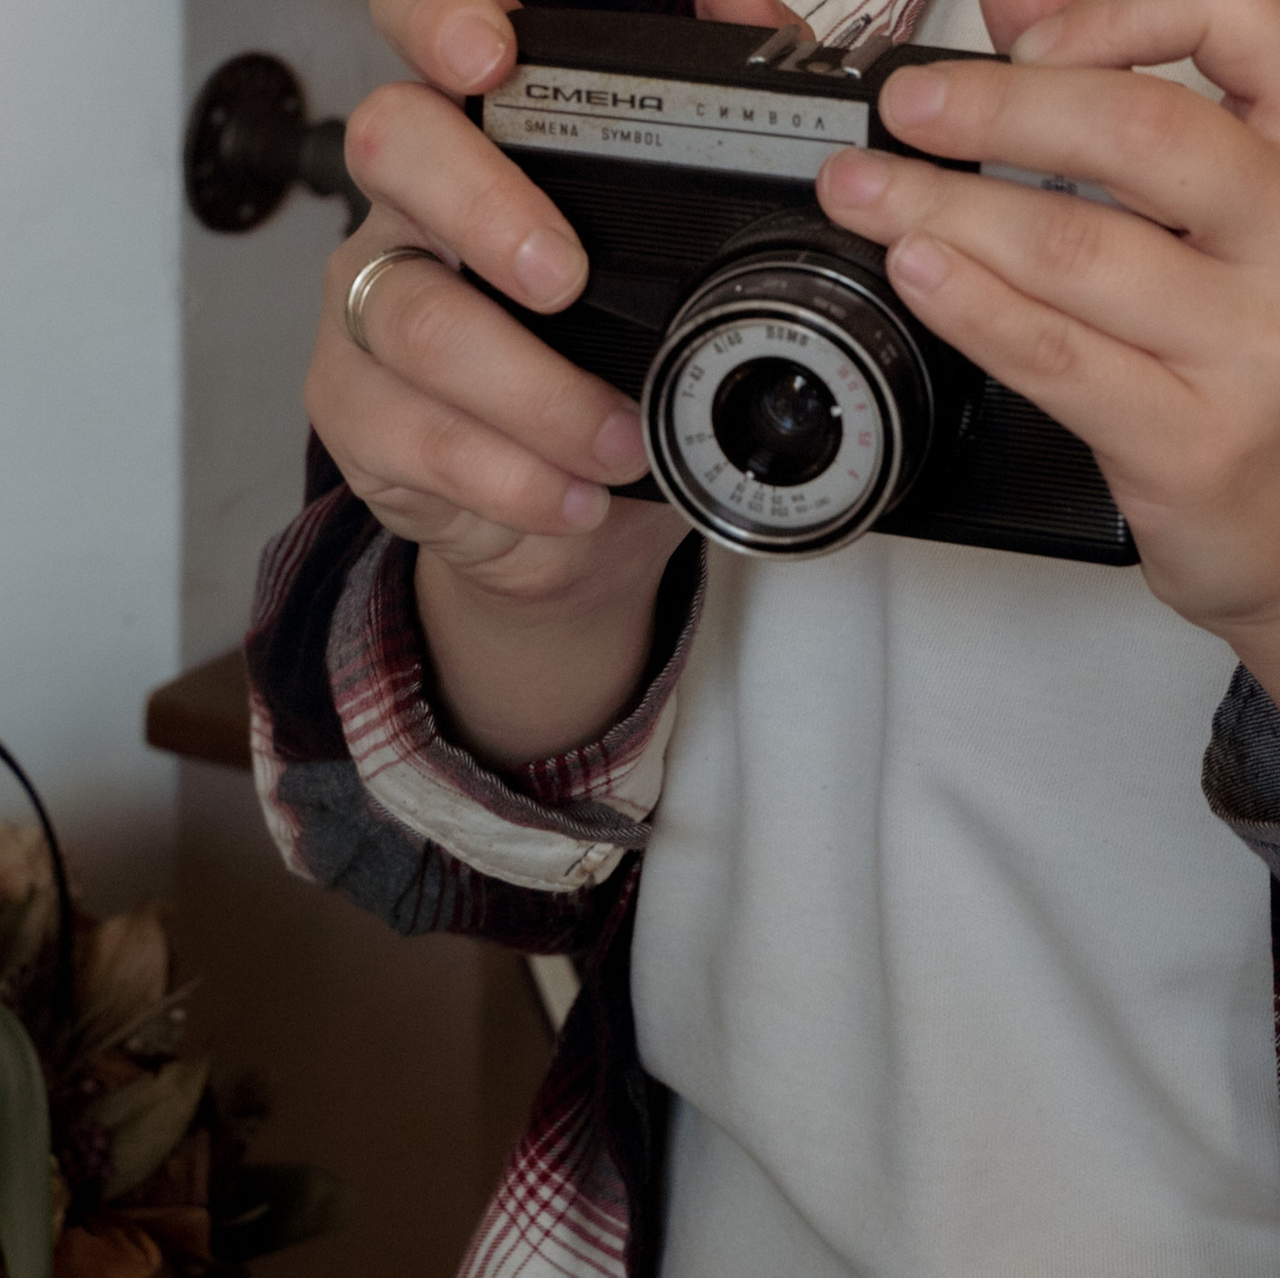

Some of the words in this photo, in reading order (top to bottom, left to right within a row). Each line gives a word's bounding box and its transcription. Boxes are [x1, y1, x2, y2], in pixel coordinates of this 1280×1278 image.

[525, 84, 663, 112] СМЕНА
[695, 102, 825, 131] СИМВОЛ
[525, 120, 579, 137] SMENA
[601, 127, 664, 147] SYMBOL
